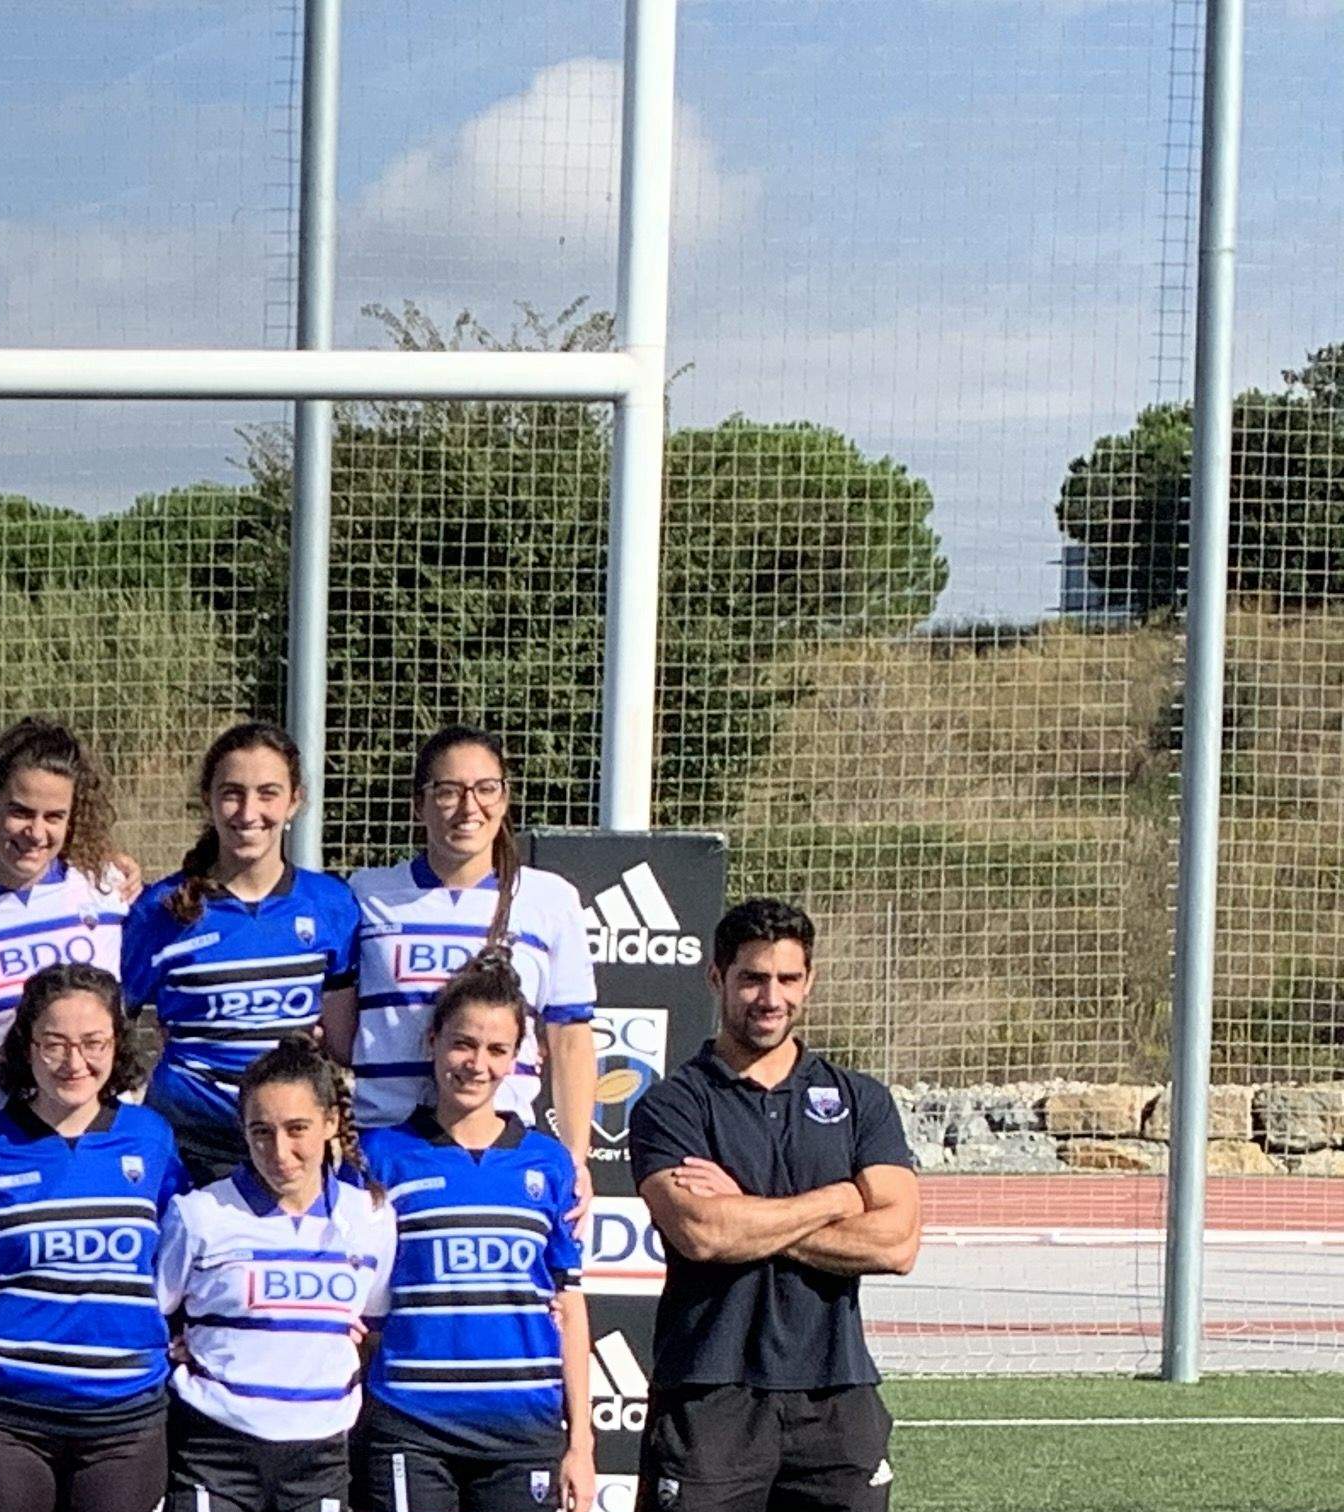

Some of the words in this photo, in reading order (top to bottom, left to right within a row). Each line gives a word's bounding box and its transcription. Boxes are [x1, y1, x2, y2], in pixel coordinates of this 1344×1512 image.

[409, 944, 474, 973] BD
[584, 926, 702, 964] didas
[591, 1017, 658, 1056] SC
[587, 1148, 622, 1161] UGBY
[45, 1229, 141, 1261] BDO
[450, 1237, 537, 1271] BDO
[264, 1270, 356, 1301] BDO
